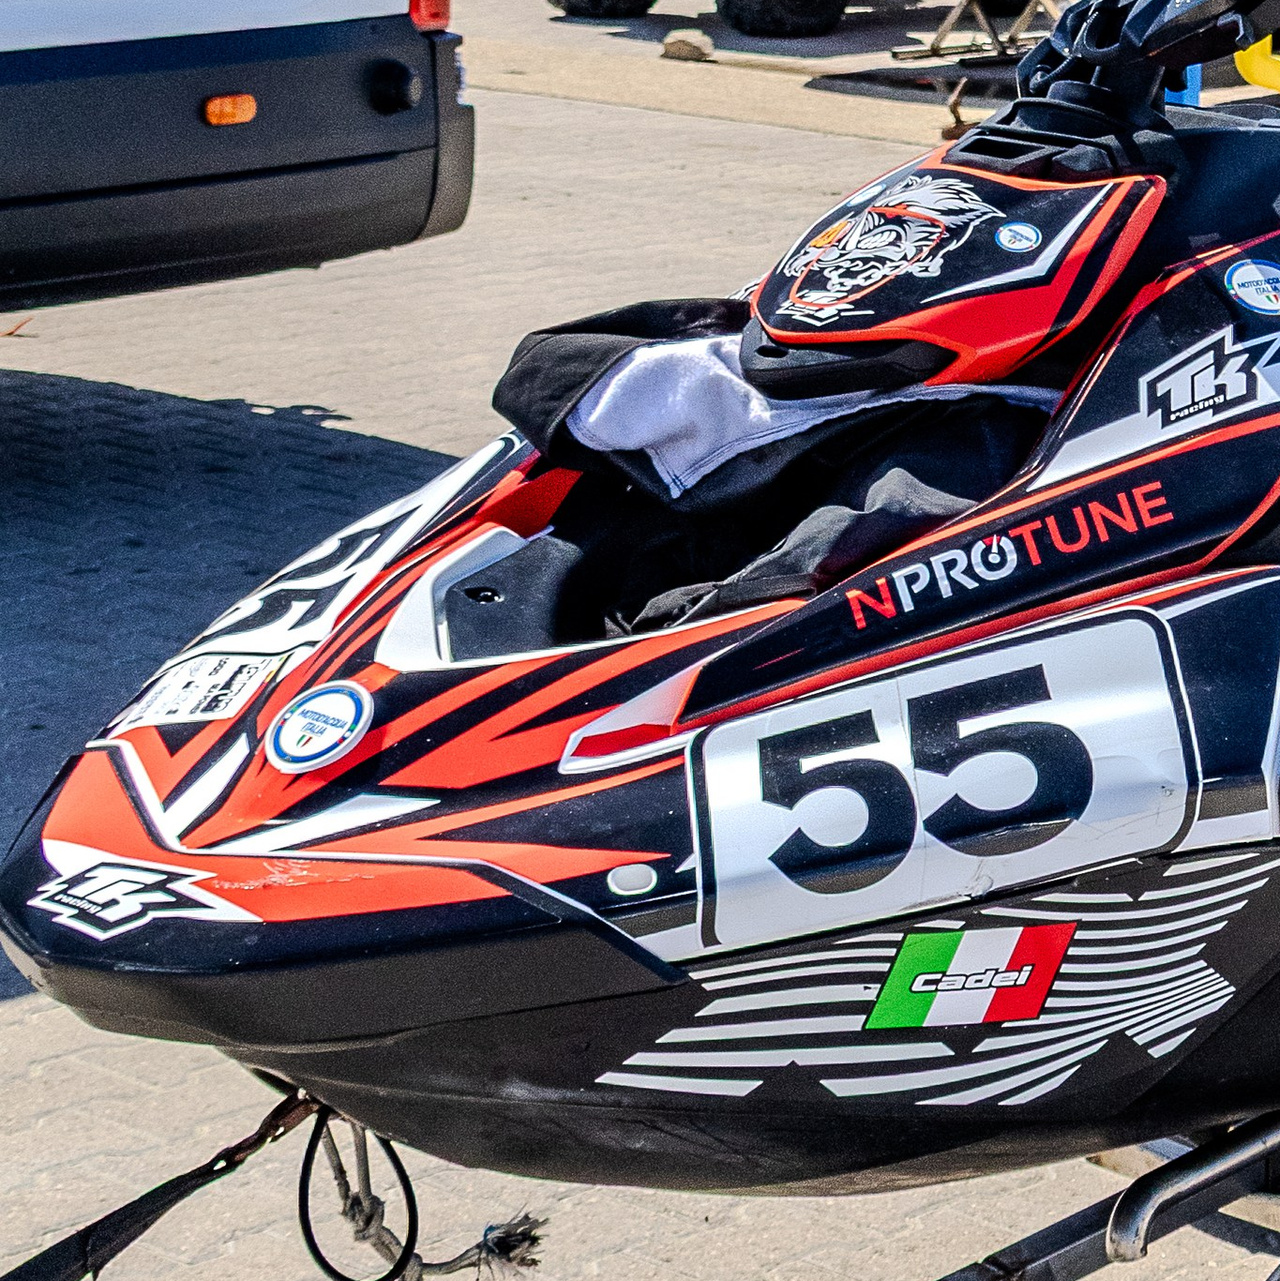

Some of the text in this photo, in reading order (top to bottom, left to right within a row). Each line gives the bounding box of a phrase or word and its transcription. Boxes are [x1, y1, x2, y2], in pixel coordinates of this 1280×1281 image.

[1255, 285, 1280, 297] ITALIA
[1156, 349, 1250, 412] TK
[844, 481, 1175, 631] NPROTUNE
[757, 662, 1095, 896] 55
[910, 964, 1033, 994] Cadei
